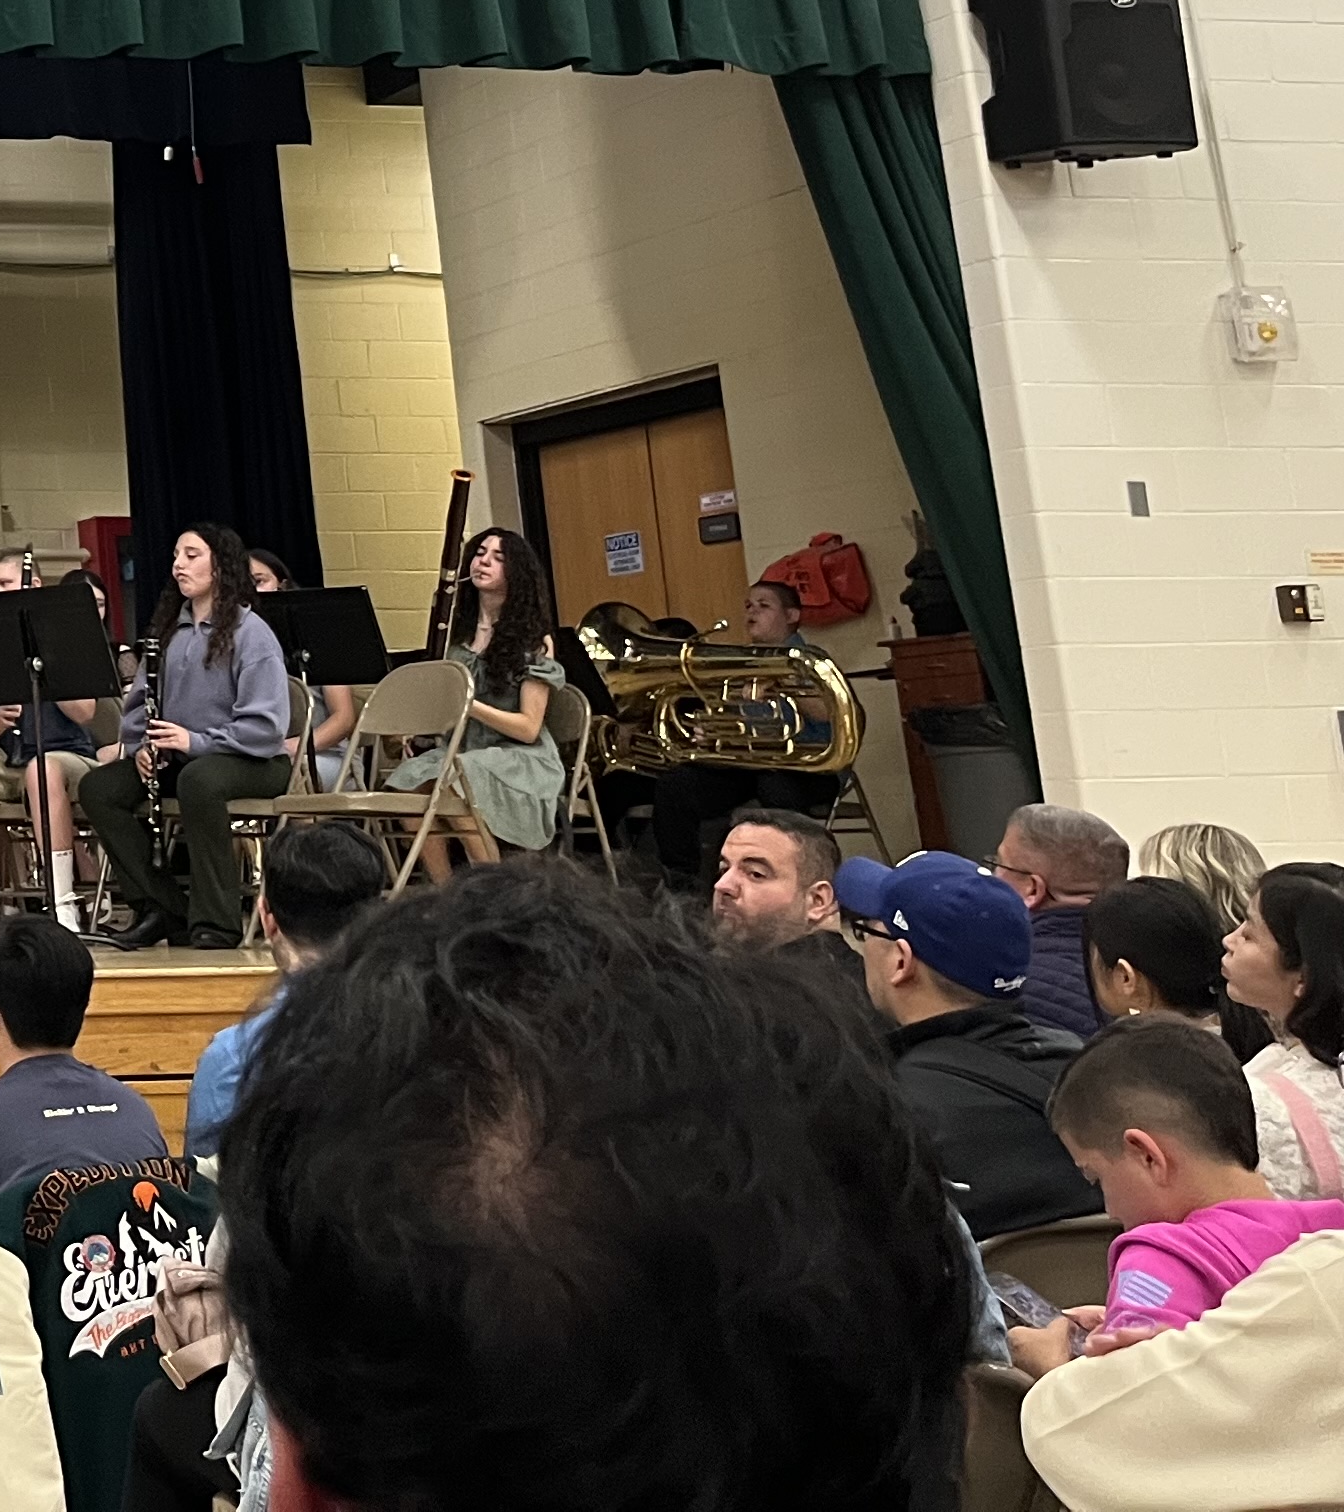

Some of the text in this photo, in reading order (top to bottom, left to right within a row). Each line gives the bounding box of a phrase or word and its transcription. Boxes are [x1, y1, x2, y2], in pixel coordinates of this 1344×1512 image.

[607, 533, 638, 550] NOTICE
[60, 1226, 205, 1322] Everst
[86, 1323, 114, 1350] The
